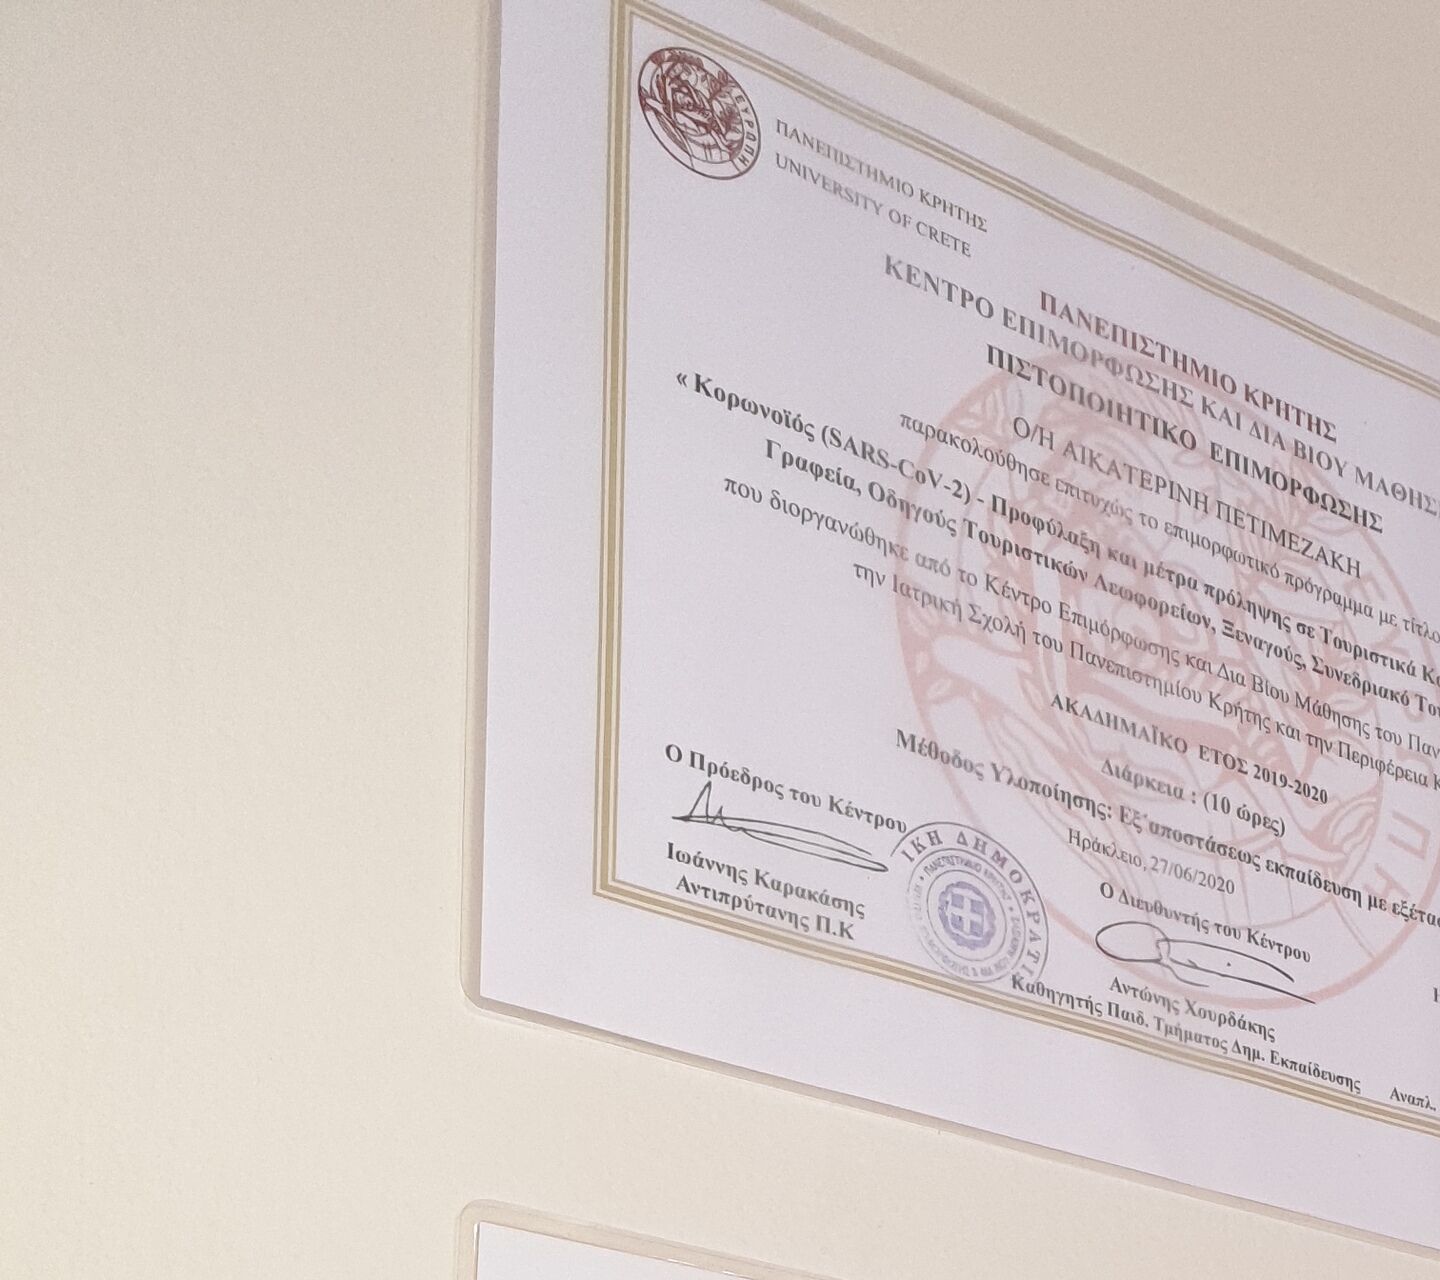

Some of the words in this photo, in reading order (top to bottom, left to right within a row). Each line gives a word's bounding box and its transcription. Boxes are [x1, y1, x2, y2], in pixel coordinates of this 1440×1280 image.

[776, 153, 883, 217] UNIVERSITY
[889, 208, 913, 229] OF
[916, 221, 972, 258] CRETE
[1254, 764, 1328, 804] 2019-2020
[1151, 856, 1234, 894] 27/06/2020
